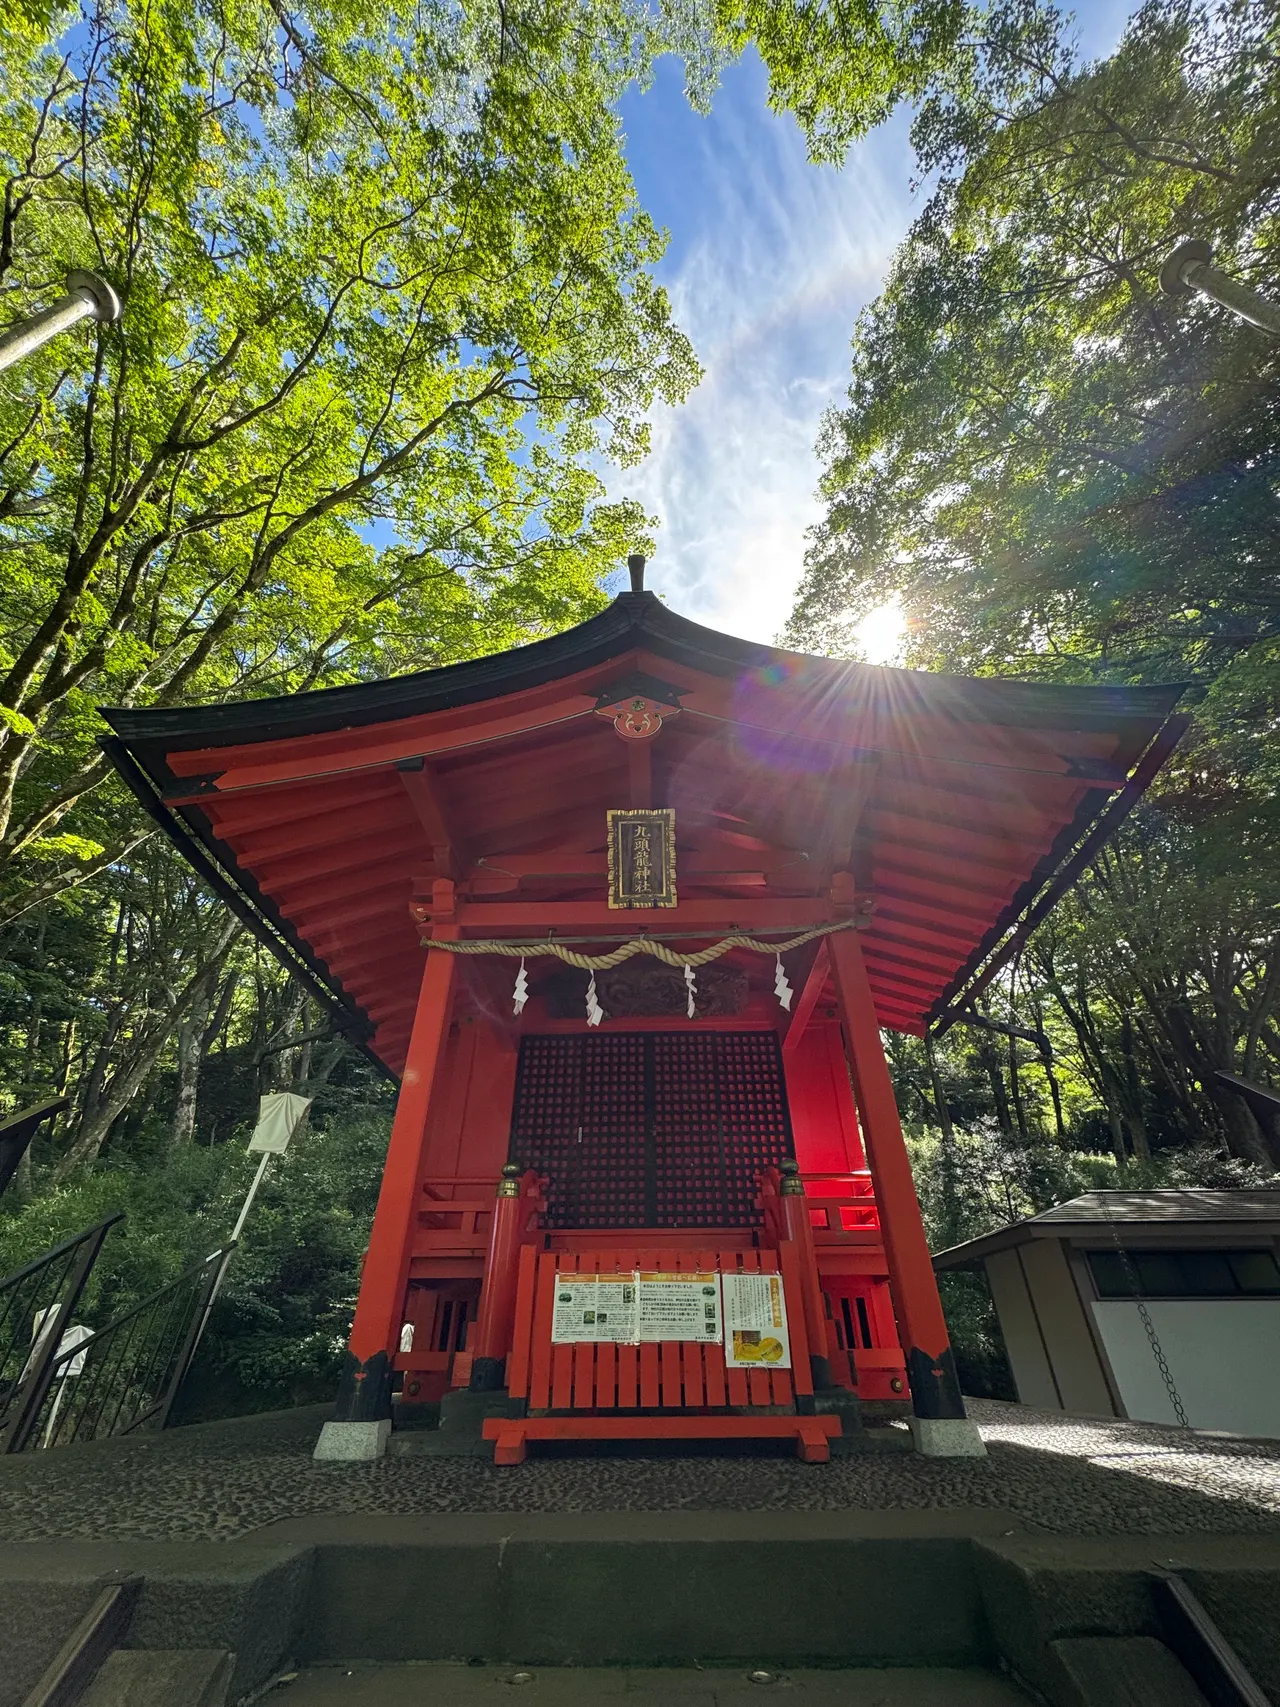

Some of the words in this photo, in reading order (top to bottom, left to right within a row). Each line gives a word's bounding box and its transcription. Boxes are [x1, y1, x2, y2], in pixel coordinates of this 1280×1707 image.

[633, 825, 652, 893] 九頭龍神社
